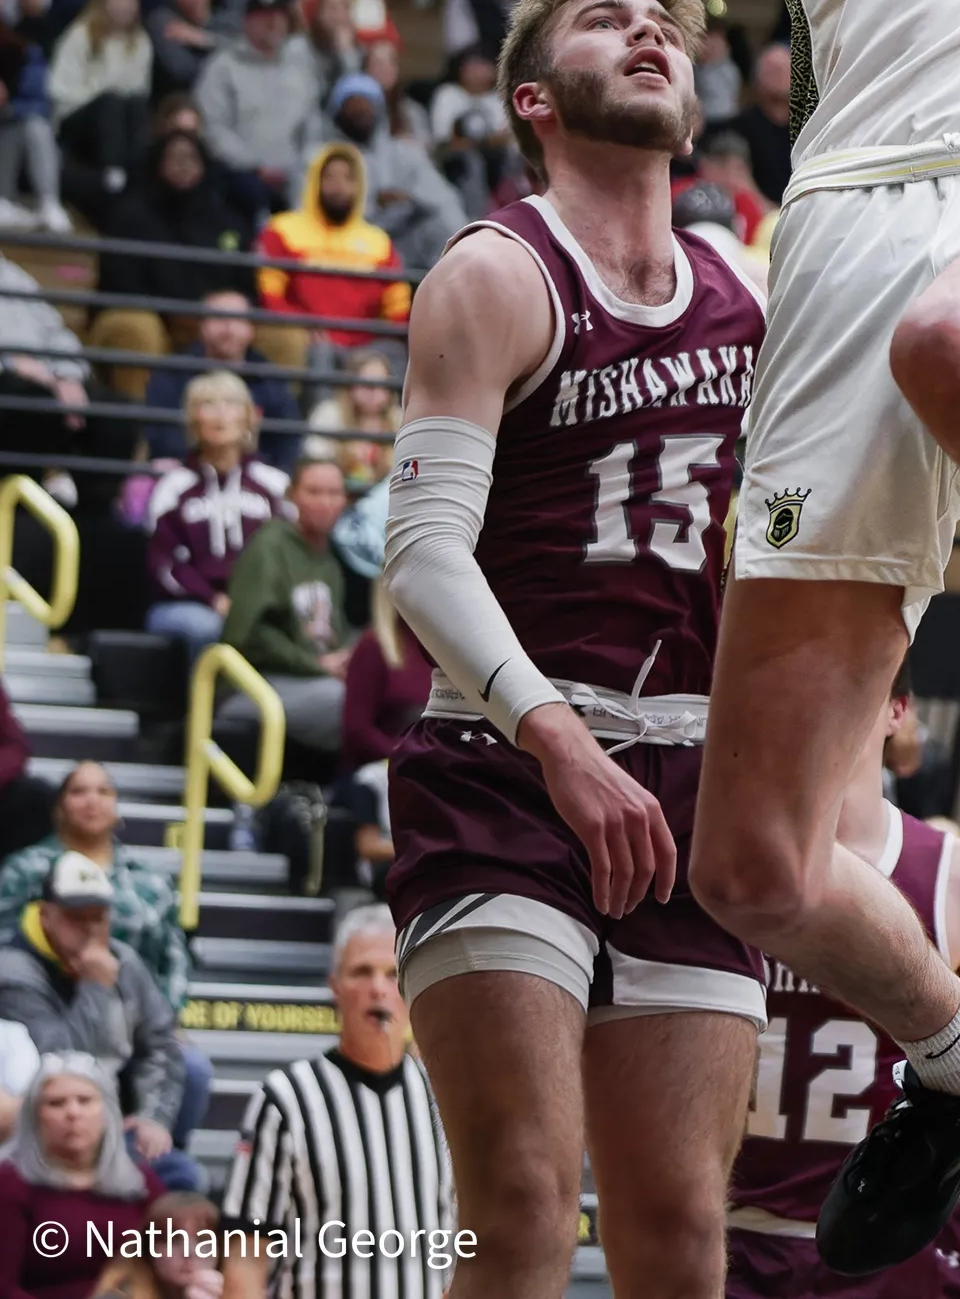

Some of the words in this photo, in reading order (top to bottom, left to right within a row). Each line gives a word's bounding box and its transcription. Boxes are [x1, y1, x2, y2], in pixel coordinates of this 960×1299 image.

[550, 346, 754, 426] MISHAWAKA
[583, 433, 726, 574] 15
[244, 1002, 342, 1034] YOURSEL
[747, 1016, 877, 1143] 12
